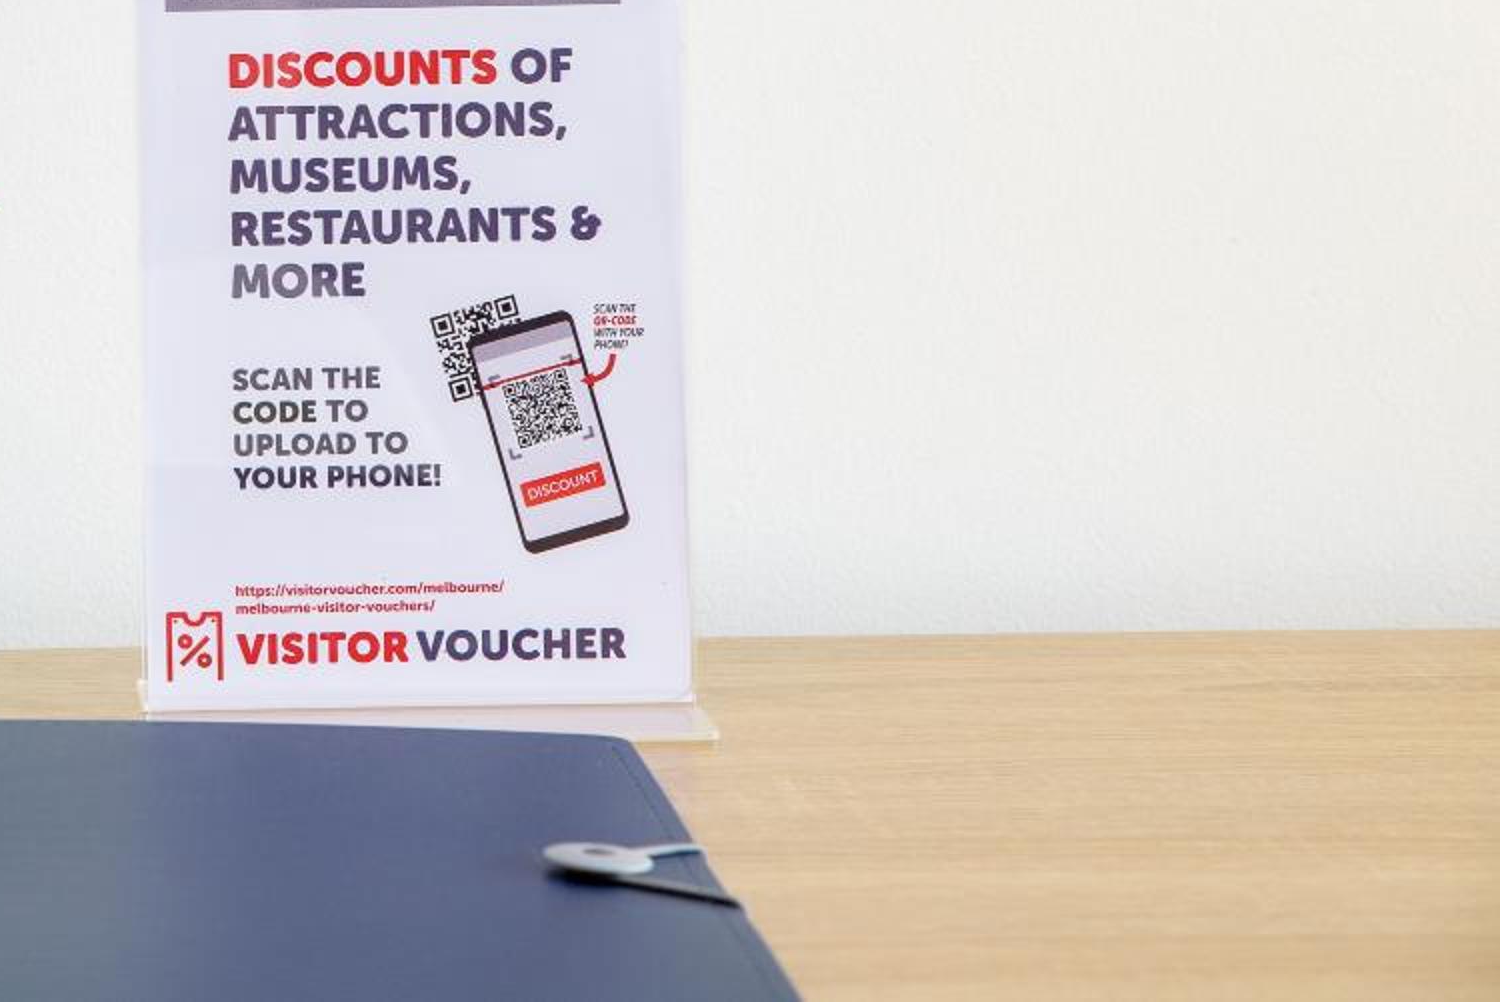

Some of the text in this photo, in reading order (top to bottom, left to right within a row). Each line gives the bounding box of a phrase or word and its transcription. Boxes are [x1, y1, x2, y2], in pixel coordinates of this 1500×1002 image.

[228, 48, 573, 89] DISCOUNTS OF
[227, 101, 567, 142] ATTRACTIONS,
[229, 155, 471, 194] MUSEUMS,
[231, 205, 602, 246] RESTAURANTS &
[231, 261, 367, 299] MORE
[593, 304, 617, 314] SCAN
[232, 366, 381, 392] SCAN THE
[232, 399, 369, 424] CODE TO
[232, 431, 409, 458] UPLOAD TO
[233, 464, 442, 490] YOUR PHONE!
[527, 469, 599, 501] DISCOUNT
[234, 579, 505, 599] https://visitorvoucher.com/melbourne/
[235, 599, 435, 616] melbourne-visitor-vouchers/
[236, 627, 627, 666] VISITOR VOUCHER
